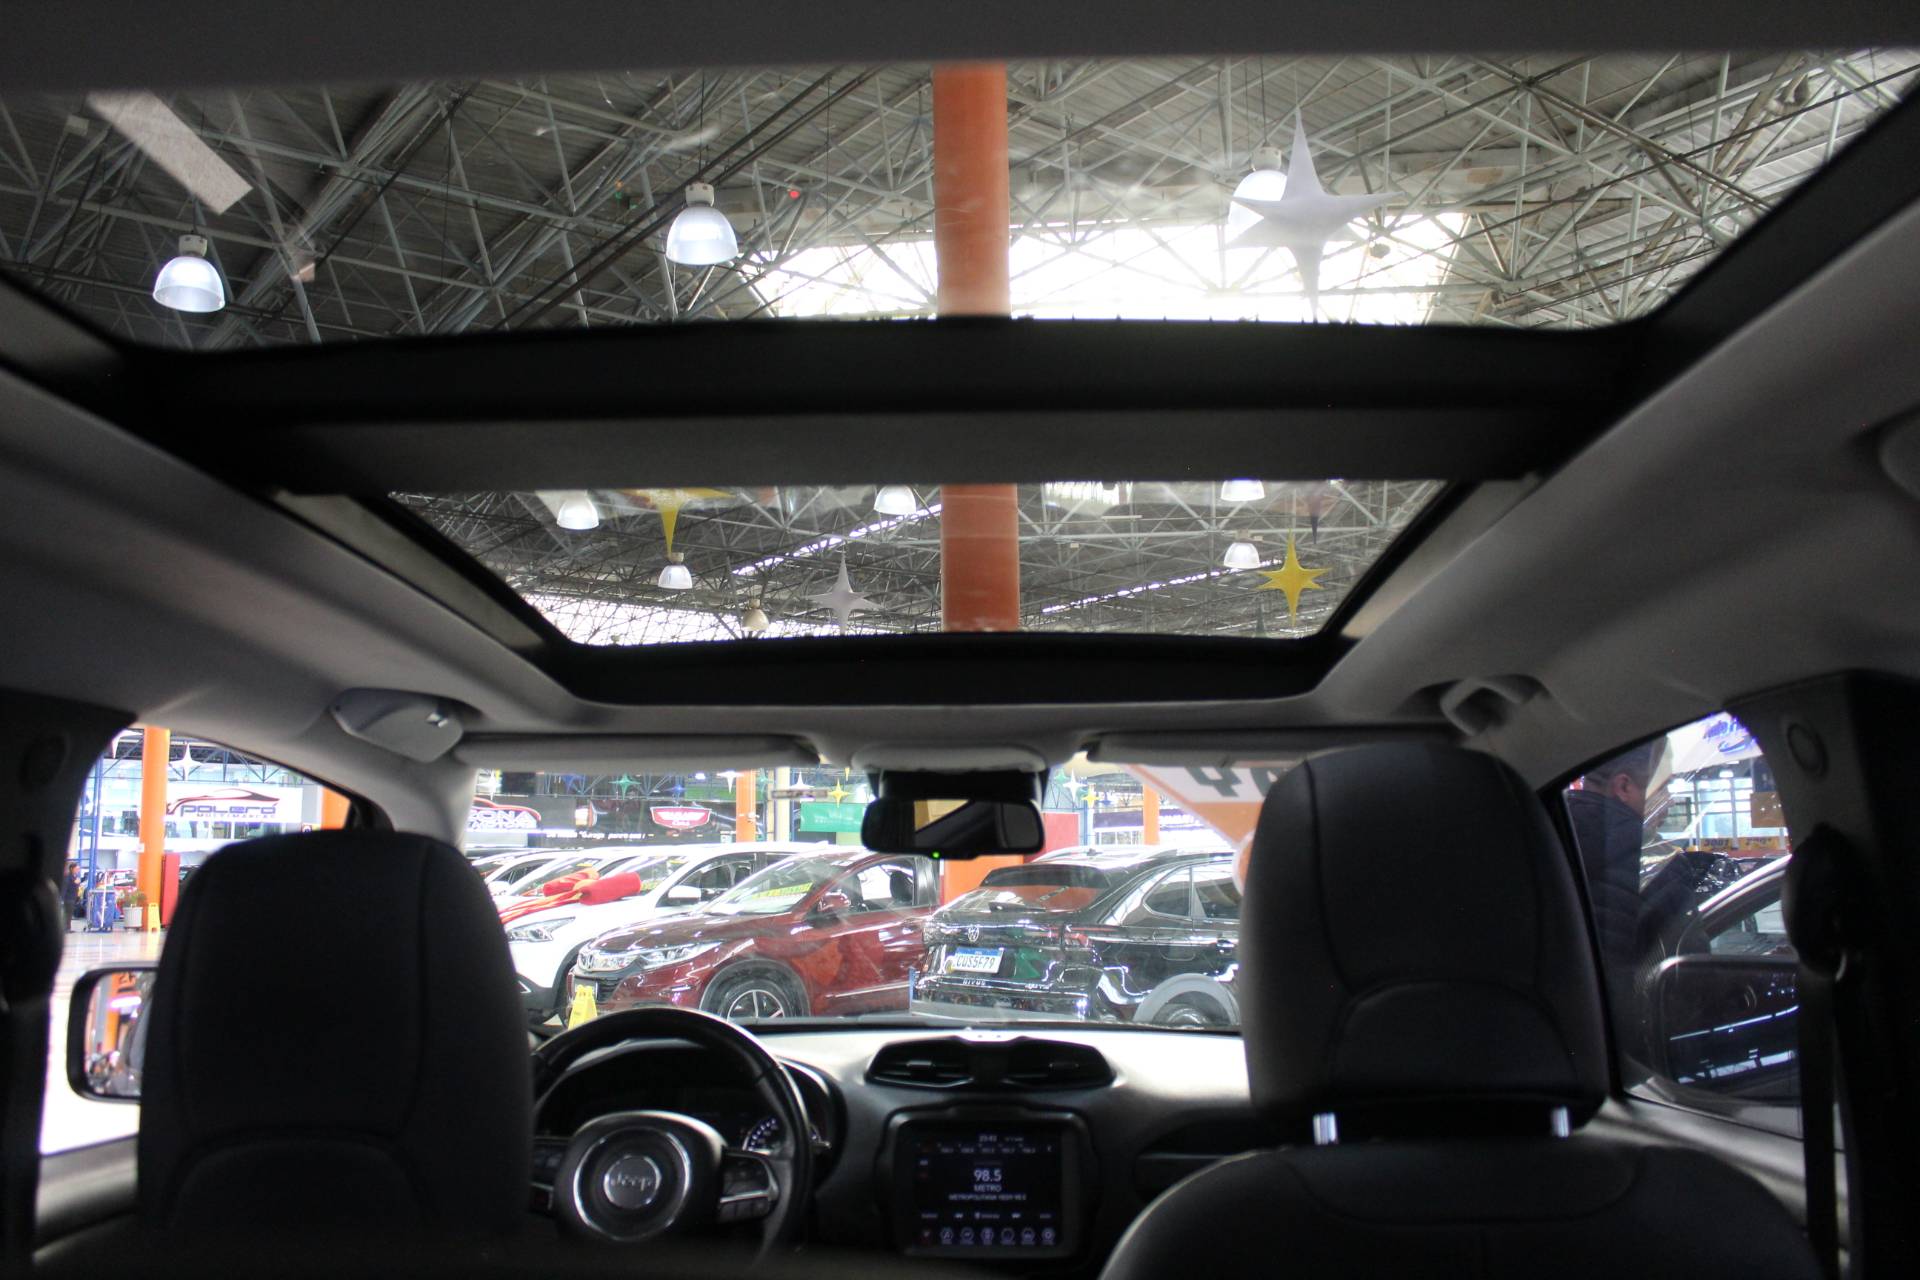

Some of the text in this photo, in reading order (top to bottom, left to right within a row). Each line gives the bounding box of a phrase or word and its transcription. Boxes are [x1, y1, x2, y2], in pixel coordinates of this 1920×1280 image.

[610, 1171, 653, 1191] Jeep
[974, 1169, 1002, 1182] 98.5
[974, 1184, 1002, 1192] METRO
